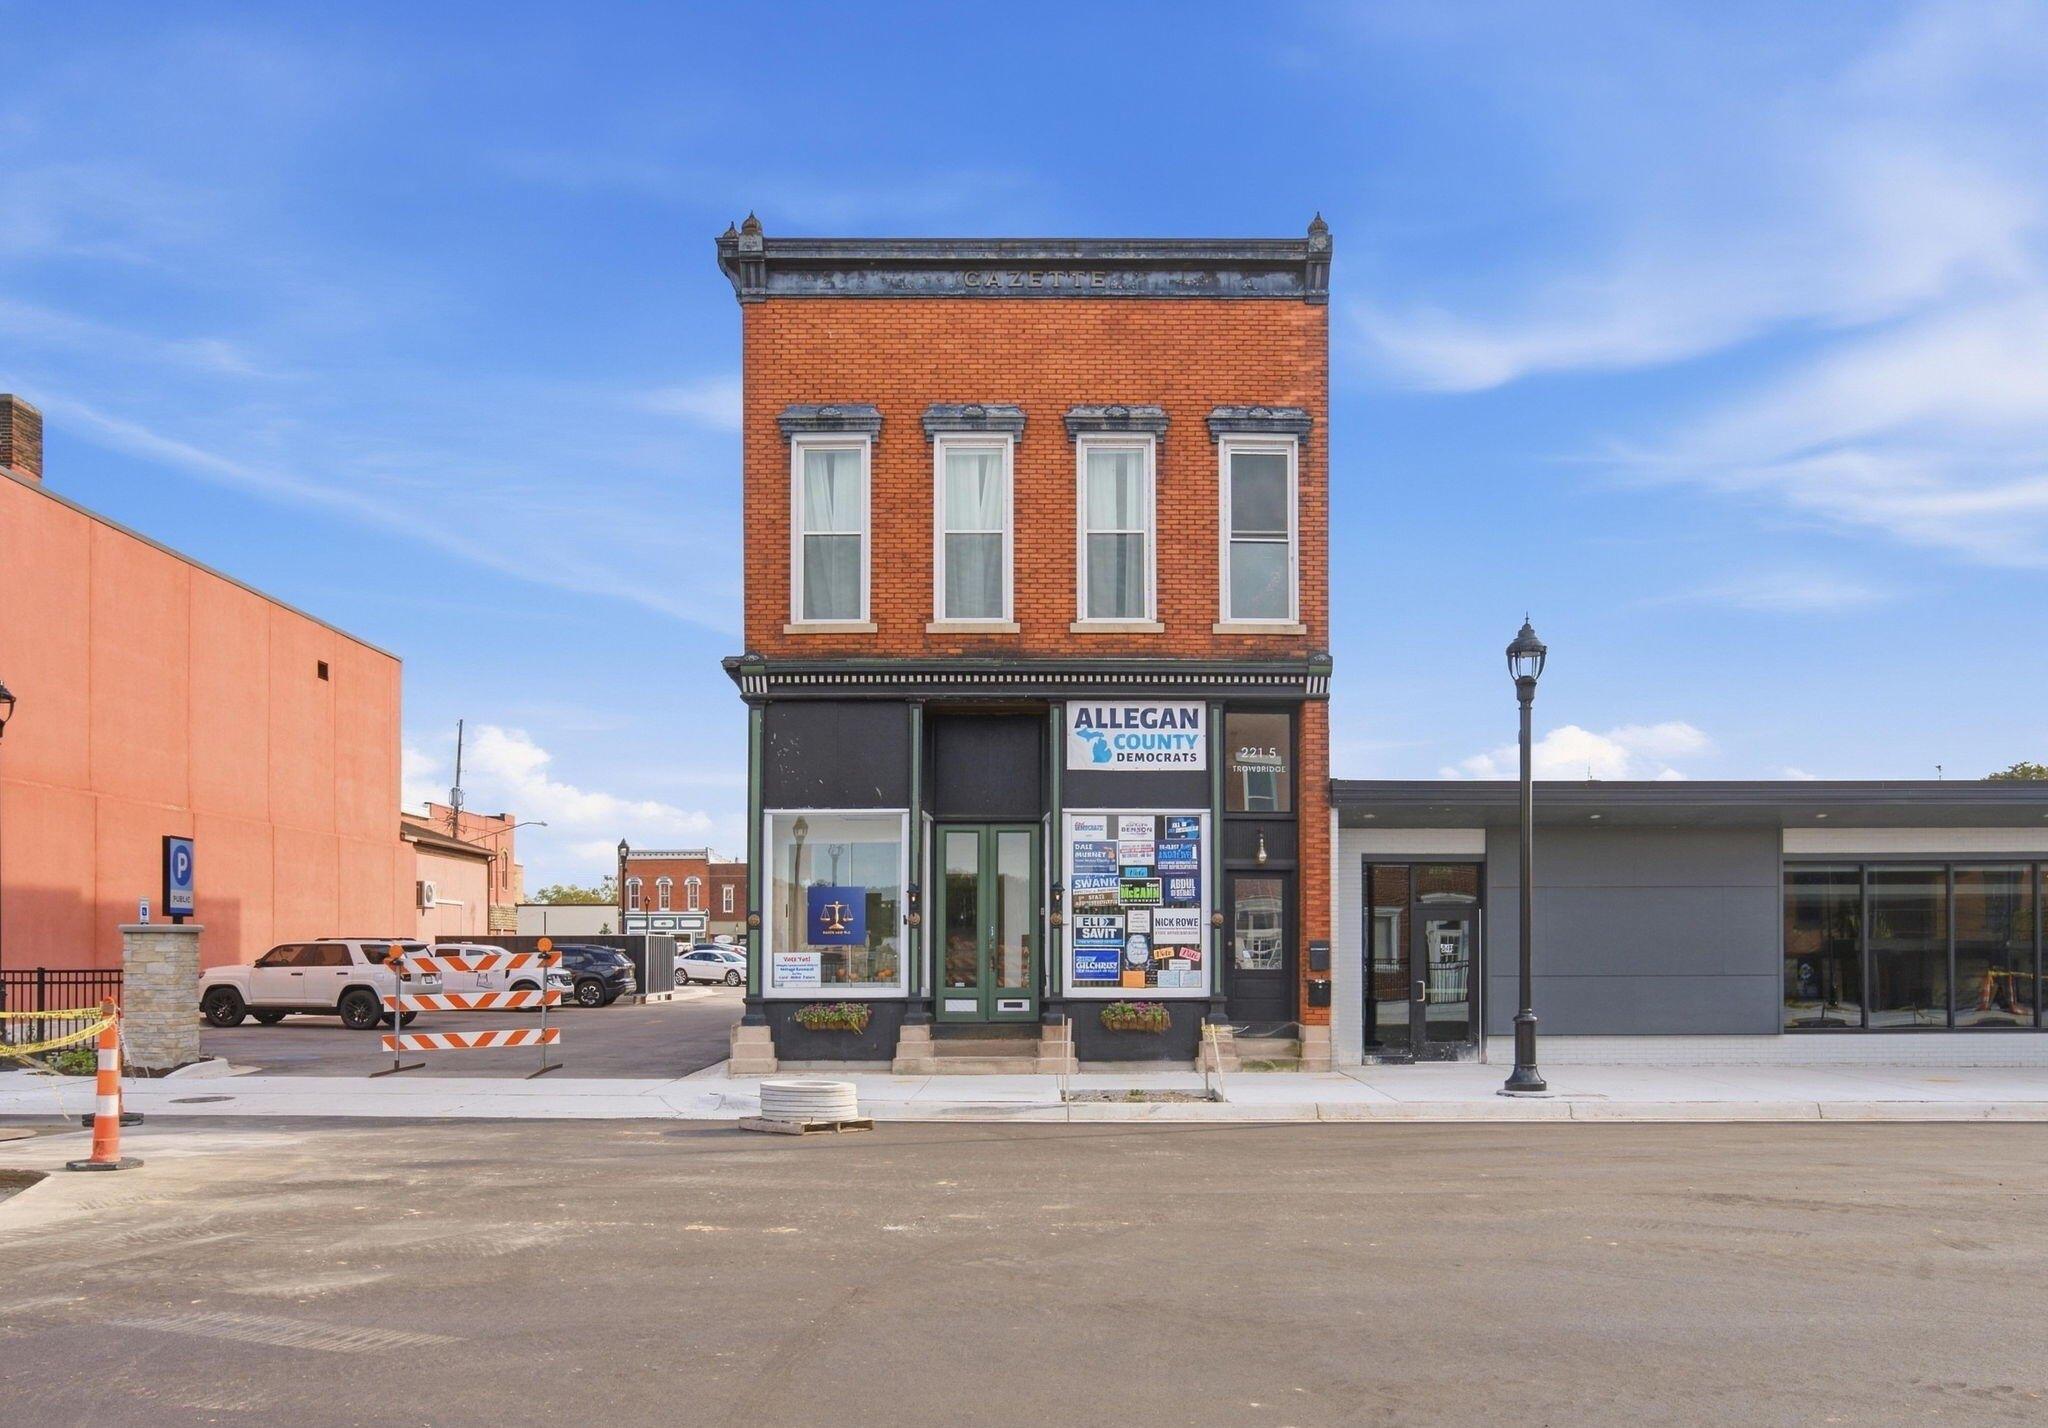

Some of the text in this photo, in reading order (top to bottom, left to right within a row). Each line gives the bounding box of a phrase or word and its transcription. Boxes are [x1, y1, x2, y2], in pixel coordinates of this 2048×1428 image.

[1074, 707, 1199, 729] ALLEGAN
[1113, 733, 1199, 750] COUNTY
[1116, 752, 1197, 762] DEMOCRATS
[1074, 876, 1117, 889] SWANK
[1170, 878, 1196, 889] ABDUL
[1120, 887, 1159, 899] McCANN
[172, 895, 192, 904] PUBLIC
[1082, 917, 1100, 926] ELI
[1155, 917, 1174, 927] NICK
[1175, 917, 1199, 927] ROWE
[1081, 928, 1117, 939] SAVIT
